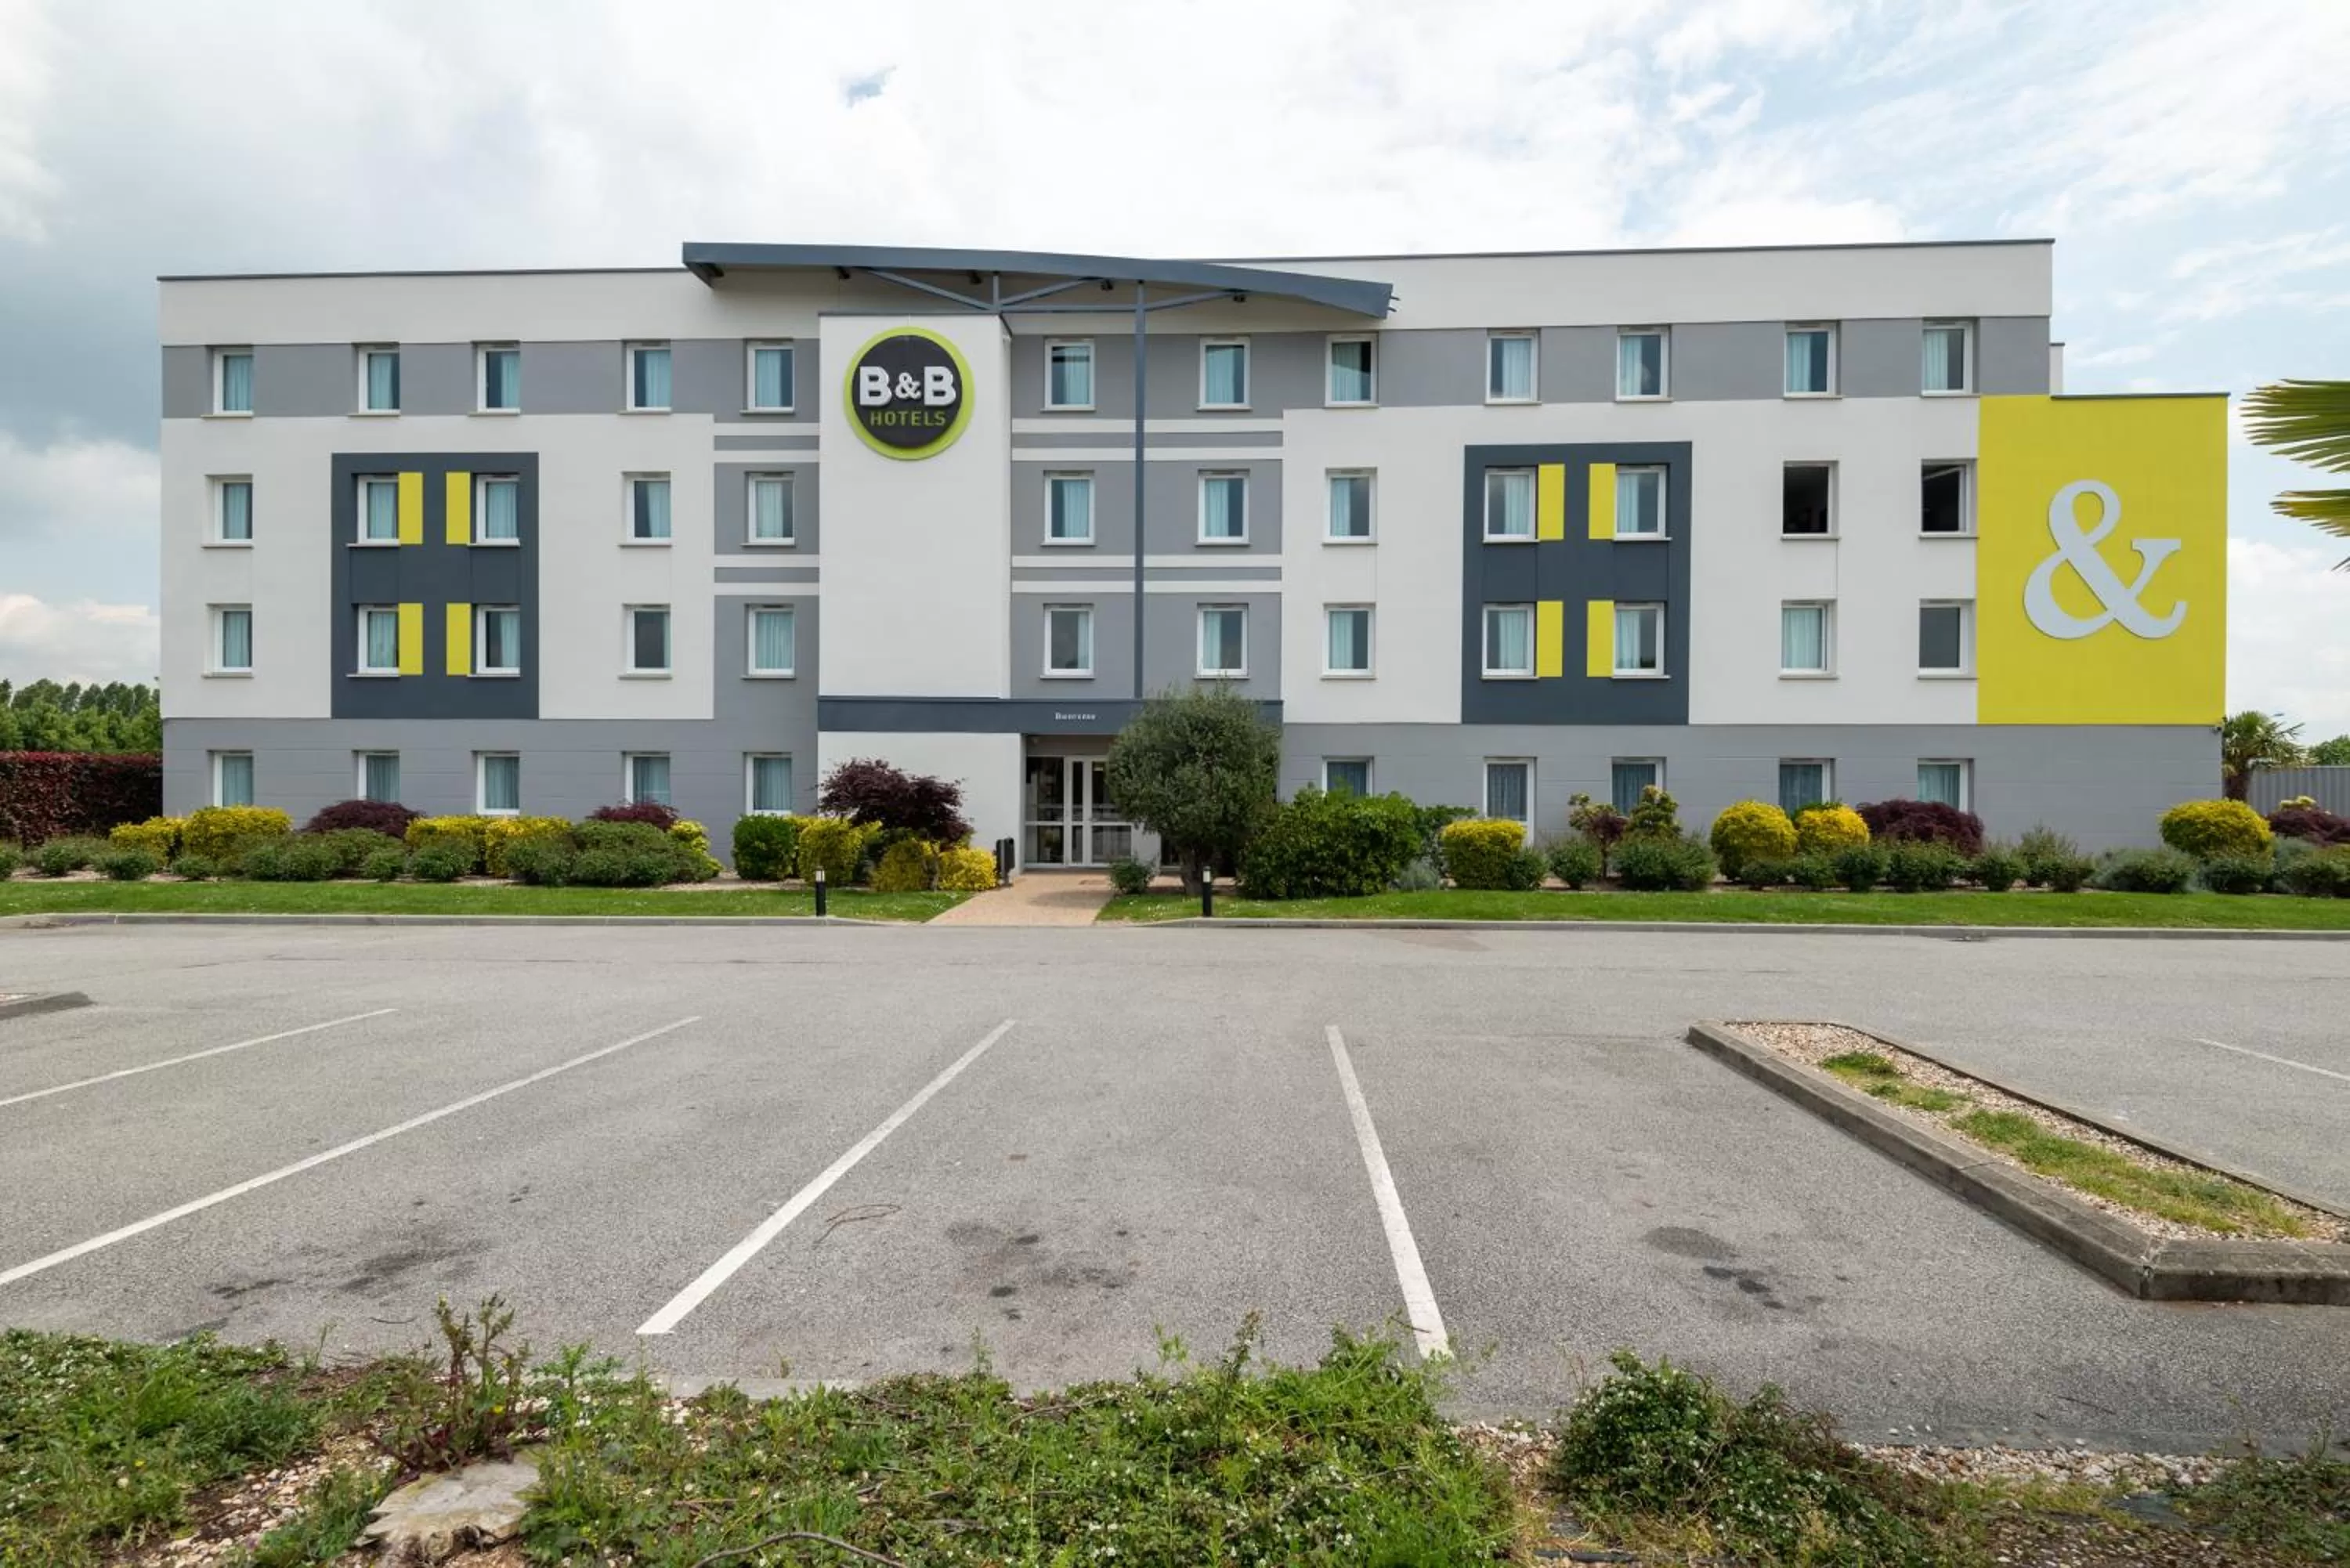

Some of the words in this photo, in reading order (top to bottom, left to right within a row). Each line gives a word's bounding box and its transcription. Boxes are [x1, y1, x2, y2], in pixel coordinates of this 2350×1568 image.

[859, 366, 956, 406] B&B
[870, 411, 945, 426] HOTELS
[2023, 479, 2188, 640] &
